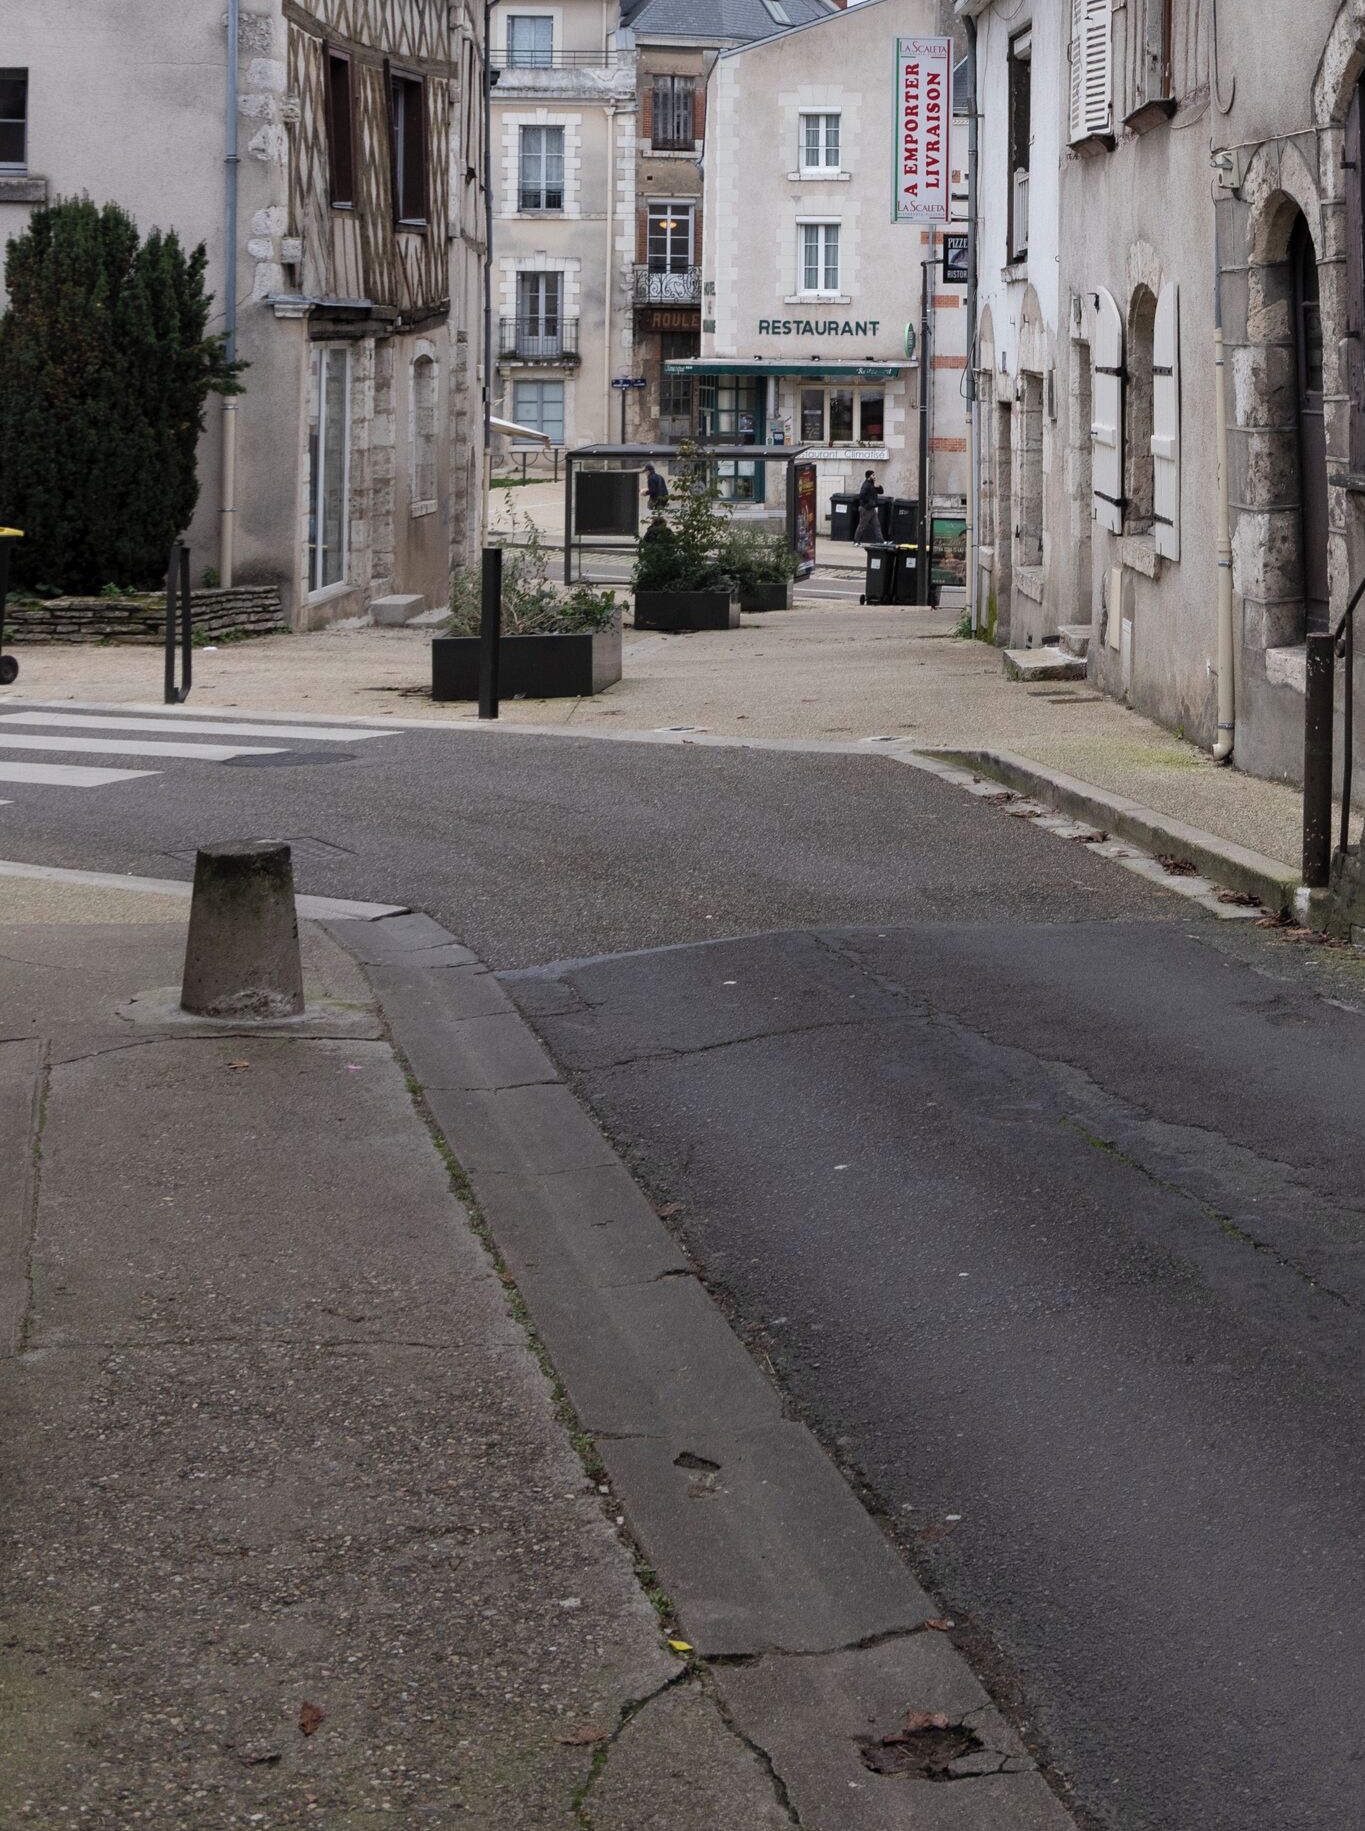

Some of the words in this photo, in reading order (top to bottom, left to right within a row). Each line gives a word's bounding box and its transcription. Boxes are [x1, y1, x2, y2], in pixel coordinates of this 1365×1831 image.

[912, 40, 947, 53] SCALETA
[903, 62, 920, 176] EMPORTER
[925, 71, 942, 189] LIVRAISON
[903, 182, 918, 197] A
[910, 199, 945, 212] SCALETA
[947, 237, 968, 248] PIZZE
[758, 318, 880, 337] RESTAURANT
[844, 449, 885, 459] Climatisé
